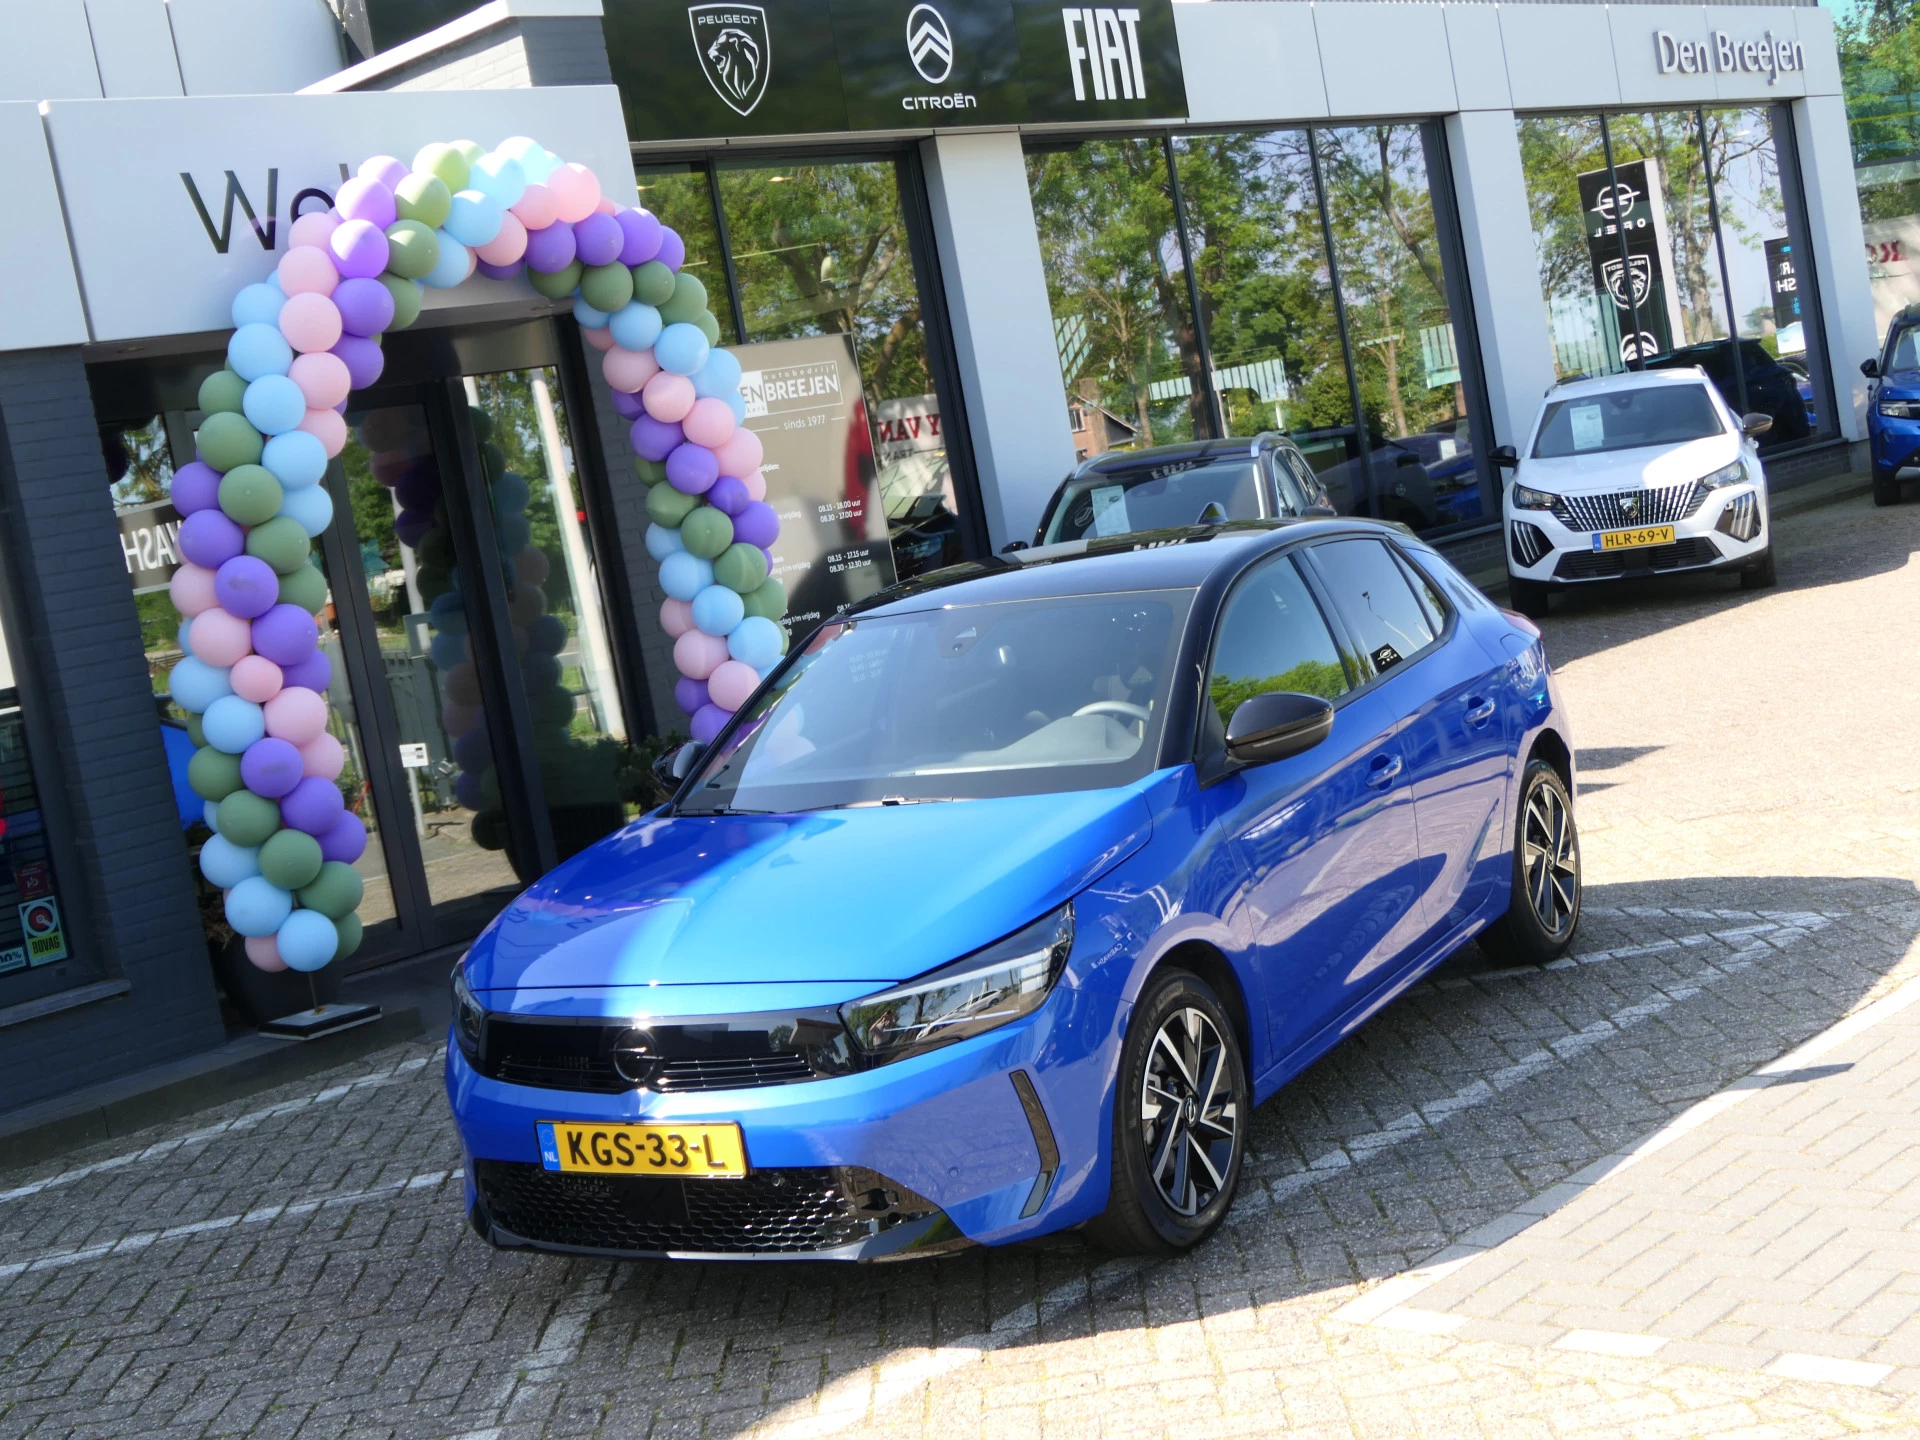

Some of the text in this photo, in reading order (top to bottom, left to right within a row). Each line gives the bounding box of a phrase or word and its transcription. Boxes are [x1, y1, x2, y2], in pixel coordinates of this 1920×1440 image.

[698, 14, 758, 25] PEUGEOT
[1062, 8, 1146, 101] FIAT
[1653, 29, 1806, 86] Den Breejen
[763, 364, 835, 380] autobedrijf
[764, 374, 839, 402] BREEJEN
[784, 415, 826, 431] sinds 1977
[1605, 528, 1669, 547] HLR-69-V
[31, 935, 61, 954] BOVAG
[544, 1151, 558, 1162] NL
[567, 1130, 726, 1168] KGS-33-L
